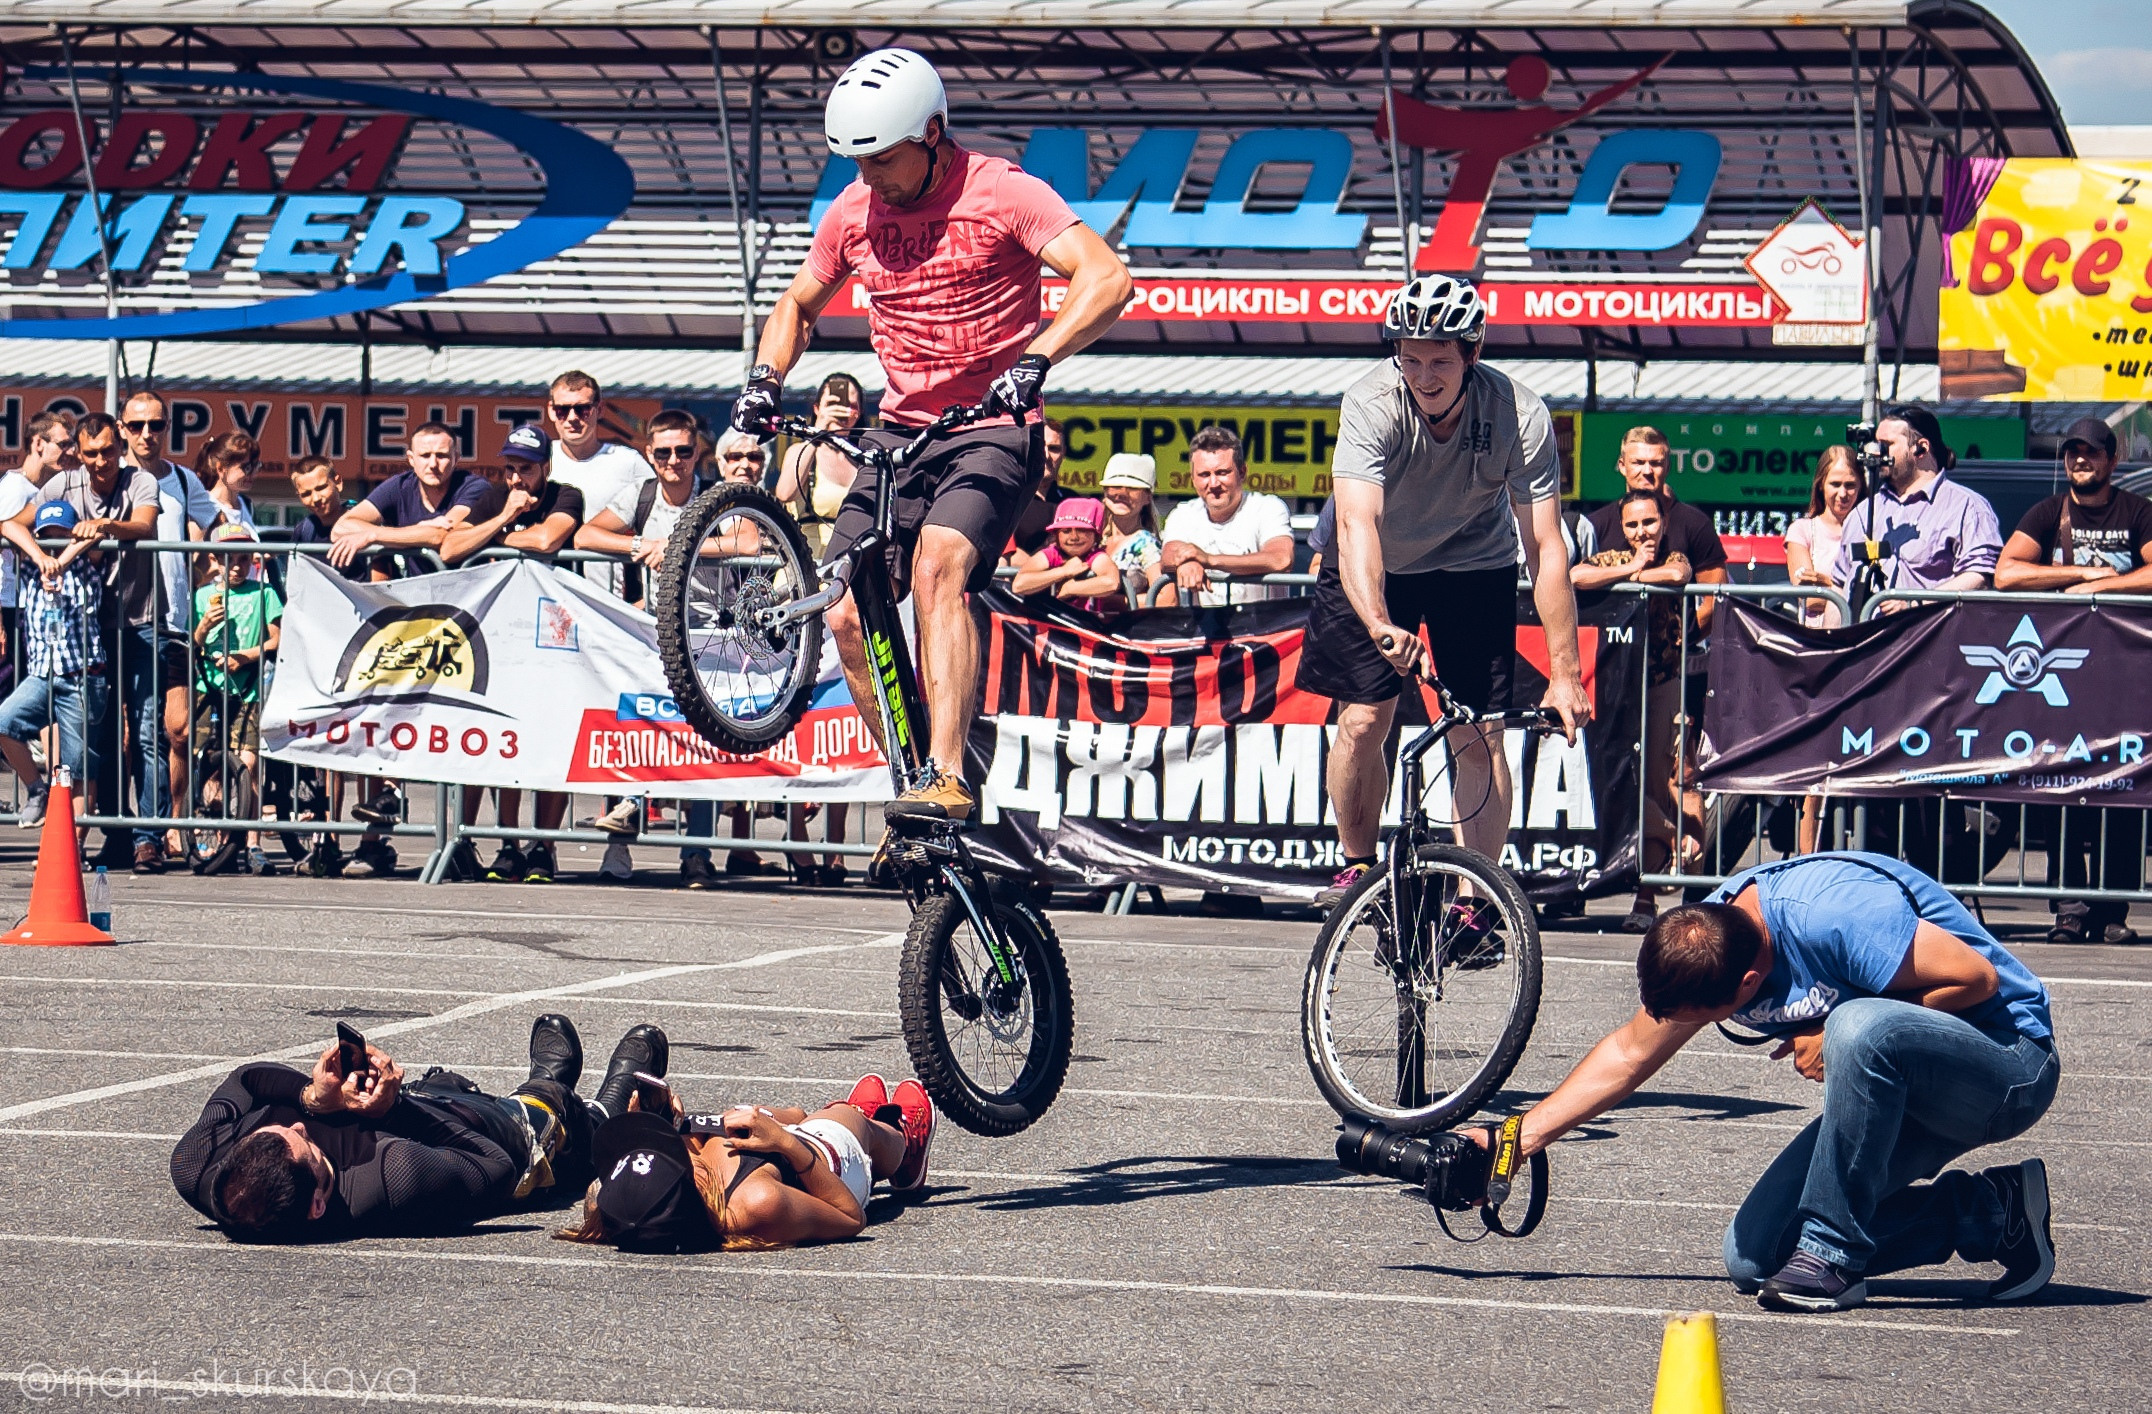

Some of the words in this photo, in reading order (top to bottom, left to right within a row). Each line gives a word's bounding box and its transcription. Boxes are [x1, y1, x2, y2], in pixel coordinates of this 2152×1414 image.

[1968, 217, 2128, 296] Всё
[1524, 288, 1772, 321] МОТОЦИКЛЫ
[288, 719, 519, 758] МОТОВОЗ
[811, 714, 878, 766] ДОРО
[1497, 1143, 1512, 1175] Nikon
